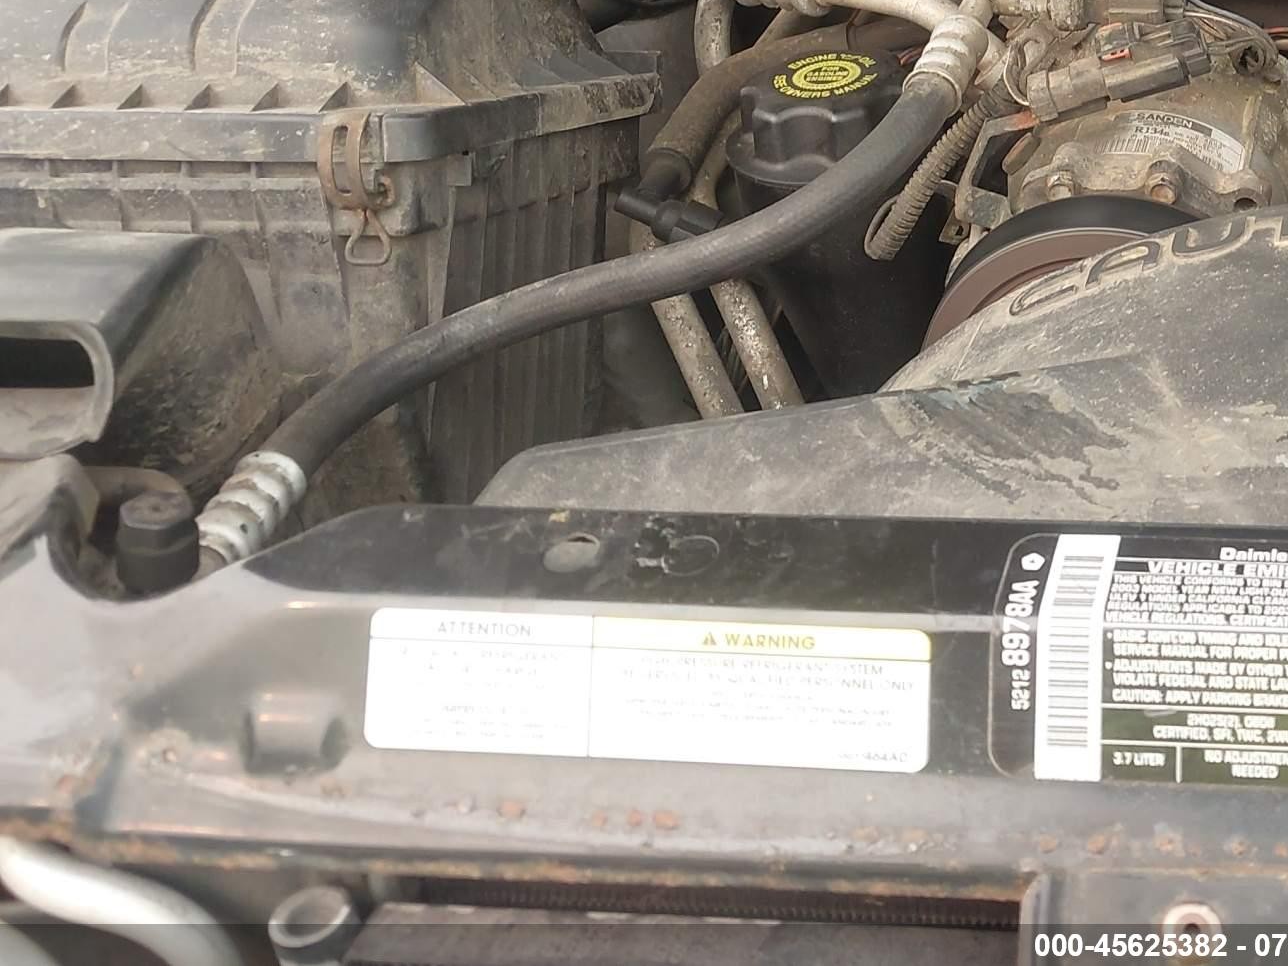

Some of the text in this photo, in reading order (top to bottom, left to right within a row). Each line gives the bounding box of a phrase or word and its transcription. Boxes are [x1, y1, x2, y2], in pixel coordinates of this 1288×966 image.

[1137, 113, 1193, 128] SANDEN
[1148, 560, 1237, 574] VEHICLE
[437, 620, 533, 639] ATTENTION
[724, 632, 817, 651] WARNING
[1001, 579, 1041, 711] 5212 8978AA
